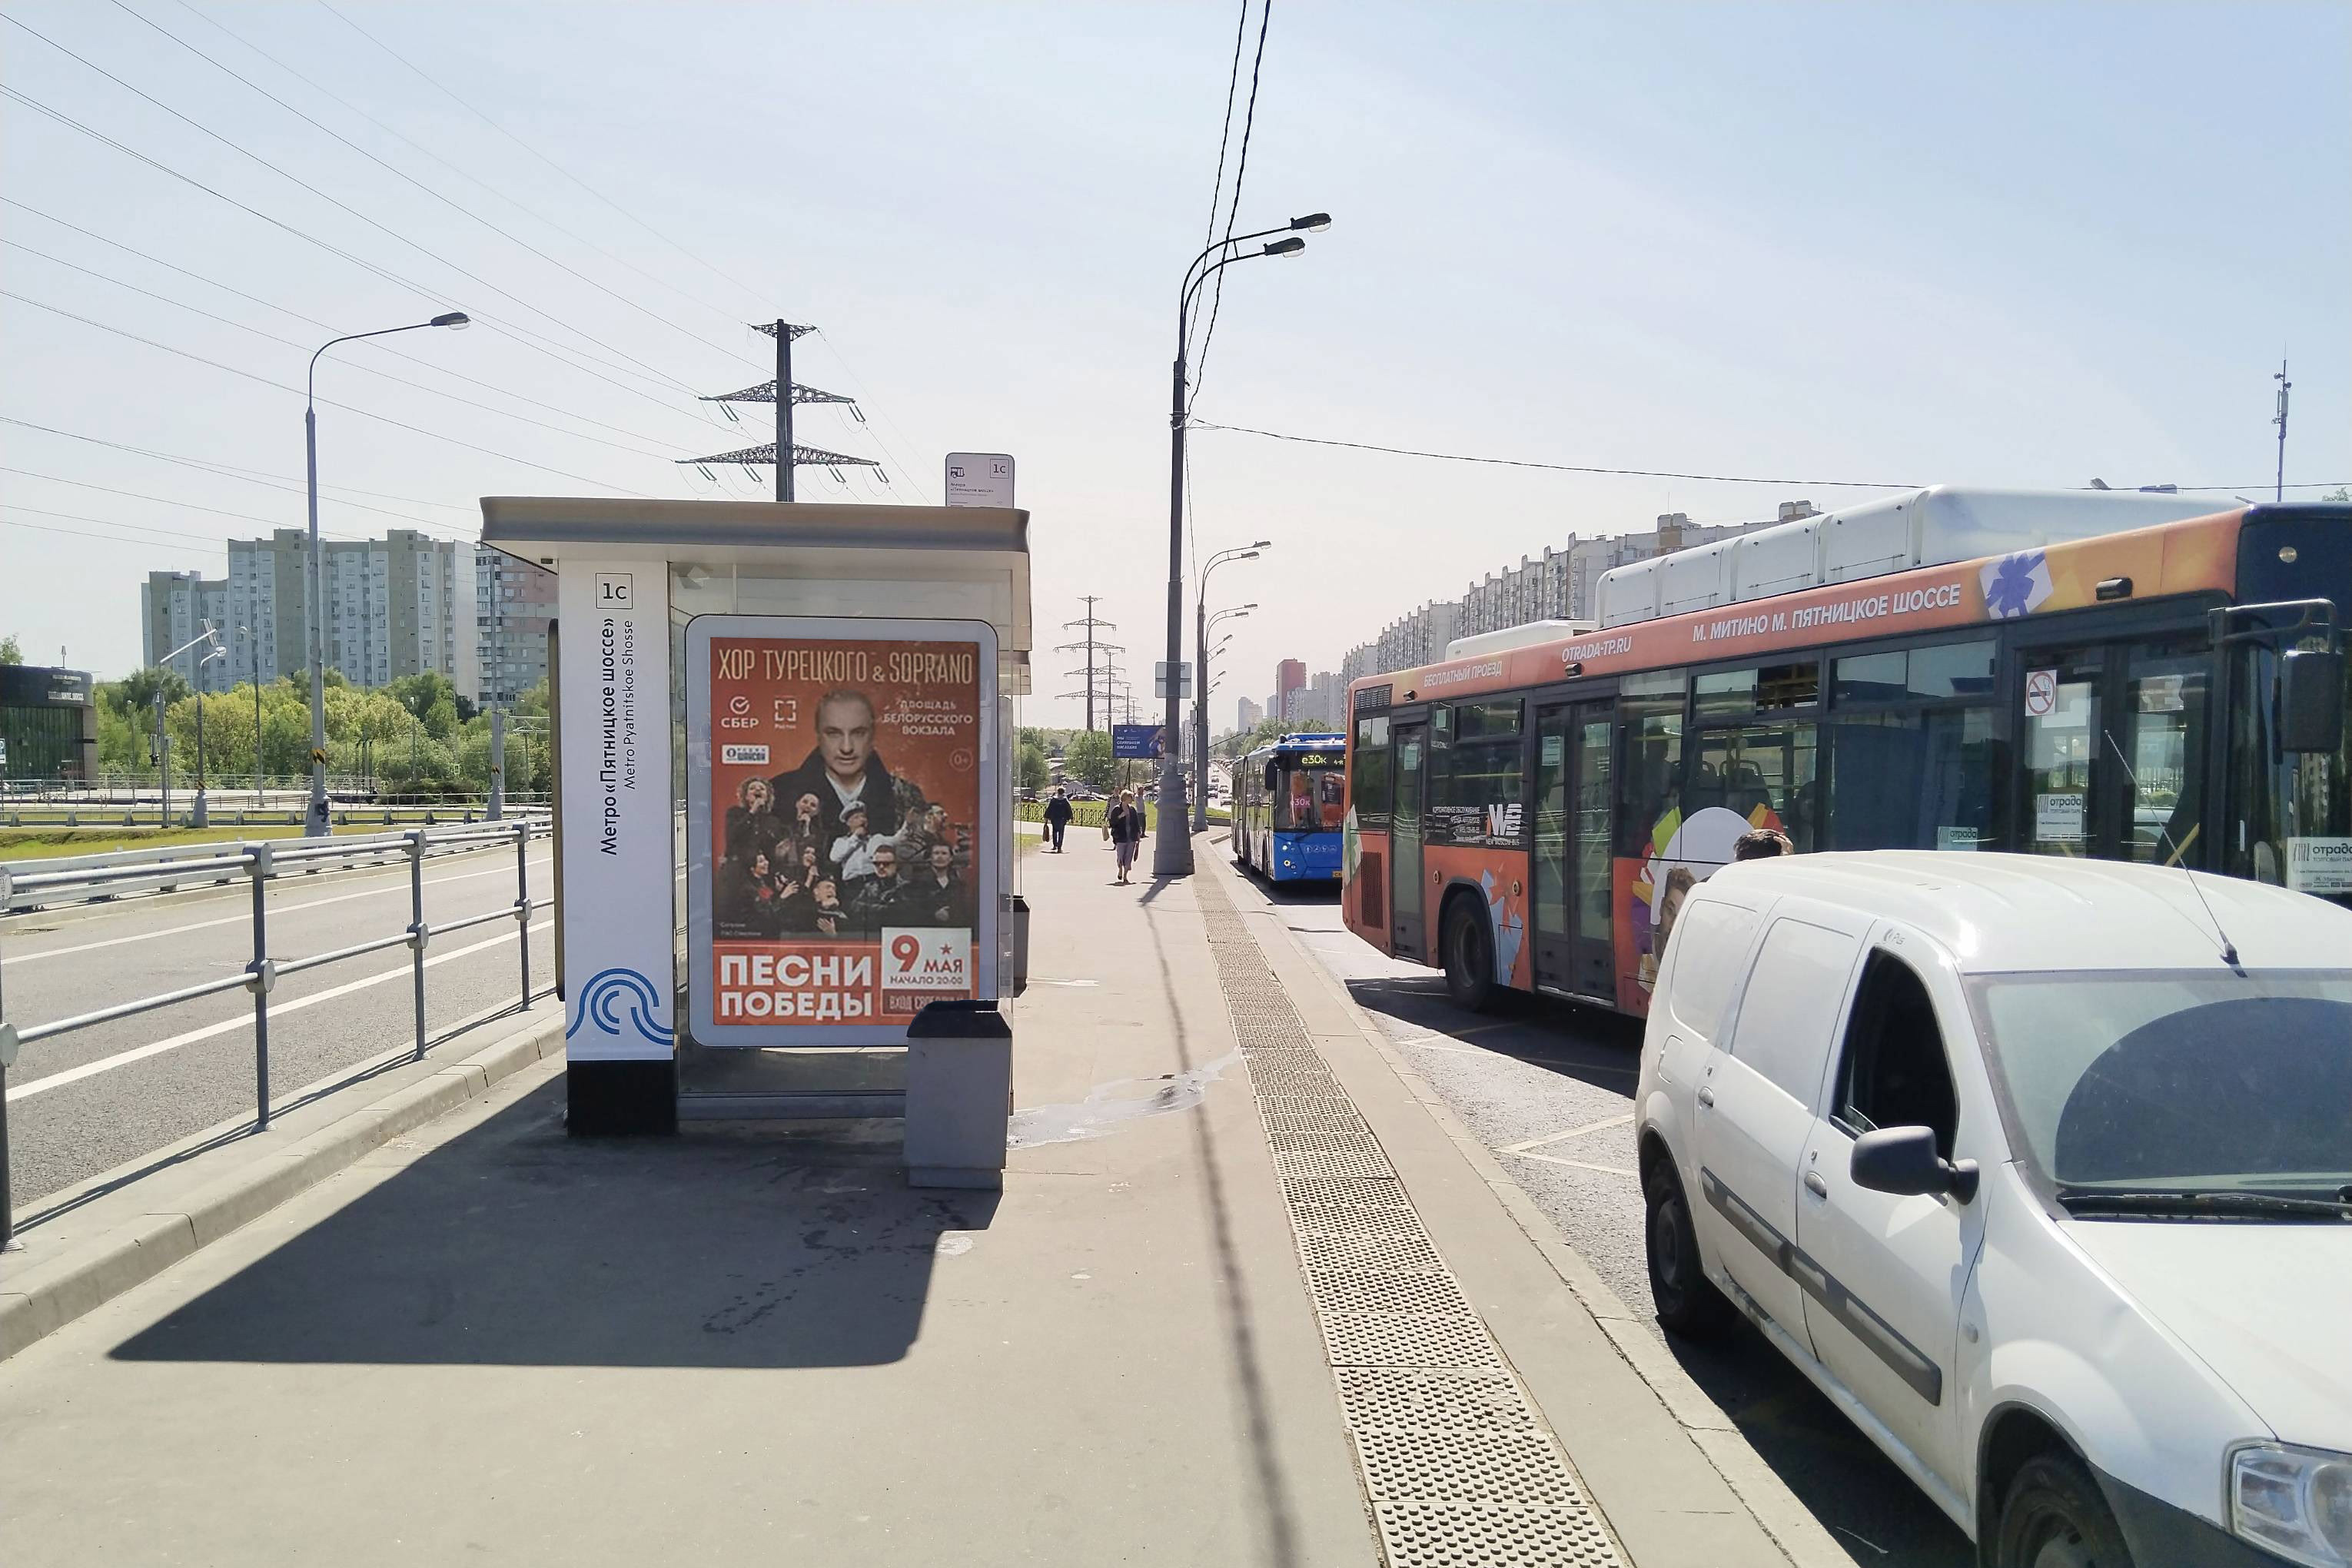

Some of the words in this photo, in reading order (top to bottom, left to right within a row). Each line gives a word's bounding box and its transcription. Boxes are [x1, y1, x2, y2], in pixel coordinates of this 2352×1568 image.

[1693, 624, 1706, 642] М.
[1709, 615, 1768, 639] МИТИНО
[1772, 613, 1787, 632] М.
[1792, 595, 1889, 629] ПЯТНИЦКОЕ
[1892, 583, 1961, 613] ШОССЕ
[602, 618, 615, 682] шоссе»
[622, 620, 633, 665] Shosse
[1562, 636, 1632, 662] OTRADA-TP.RU
[718, 649, 755, 680] ХОР
[762, 650, 867, 683] ТУРЕЦКОГО
[872, 665, 885, 683] &
[889, 653, 972, 684] SOPRANO
[1423, 665, 1470, 687] БЕСПЛАТНЫЙ
[1470, 661, 1502, 680] ПРОЕЗД
[622, 669, 636, 745] Pyatnitskoe
[883, 713, 973, 724] БЕЛОРУССКОГО
[900, 700, 956, 709] ПЛОЩАДЬ
[721, 717, 759, 729] СБЕР
[902, 726, 955, 735] ВОКЗАЛА
[600, 686, 618, 793] «Пятницкое
[623, 749, 636, 790] Metro
[2050, 795, 2081, 809] отрада
[600, 796, 620, 855] Метро
[892, 934, 920, 972] 9
[924, 958, 963, 973] МАЯ
[721, 955, 872, 987] ПЕСНИ
[890, 975, 935, 985] НАЧАЛО
[722, 992, 872, 1021] ПОБЕДЫ
